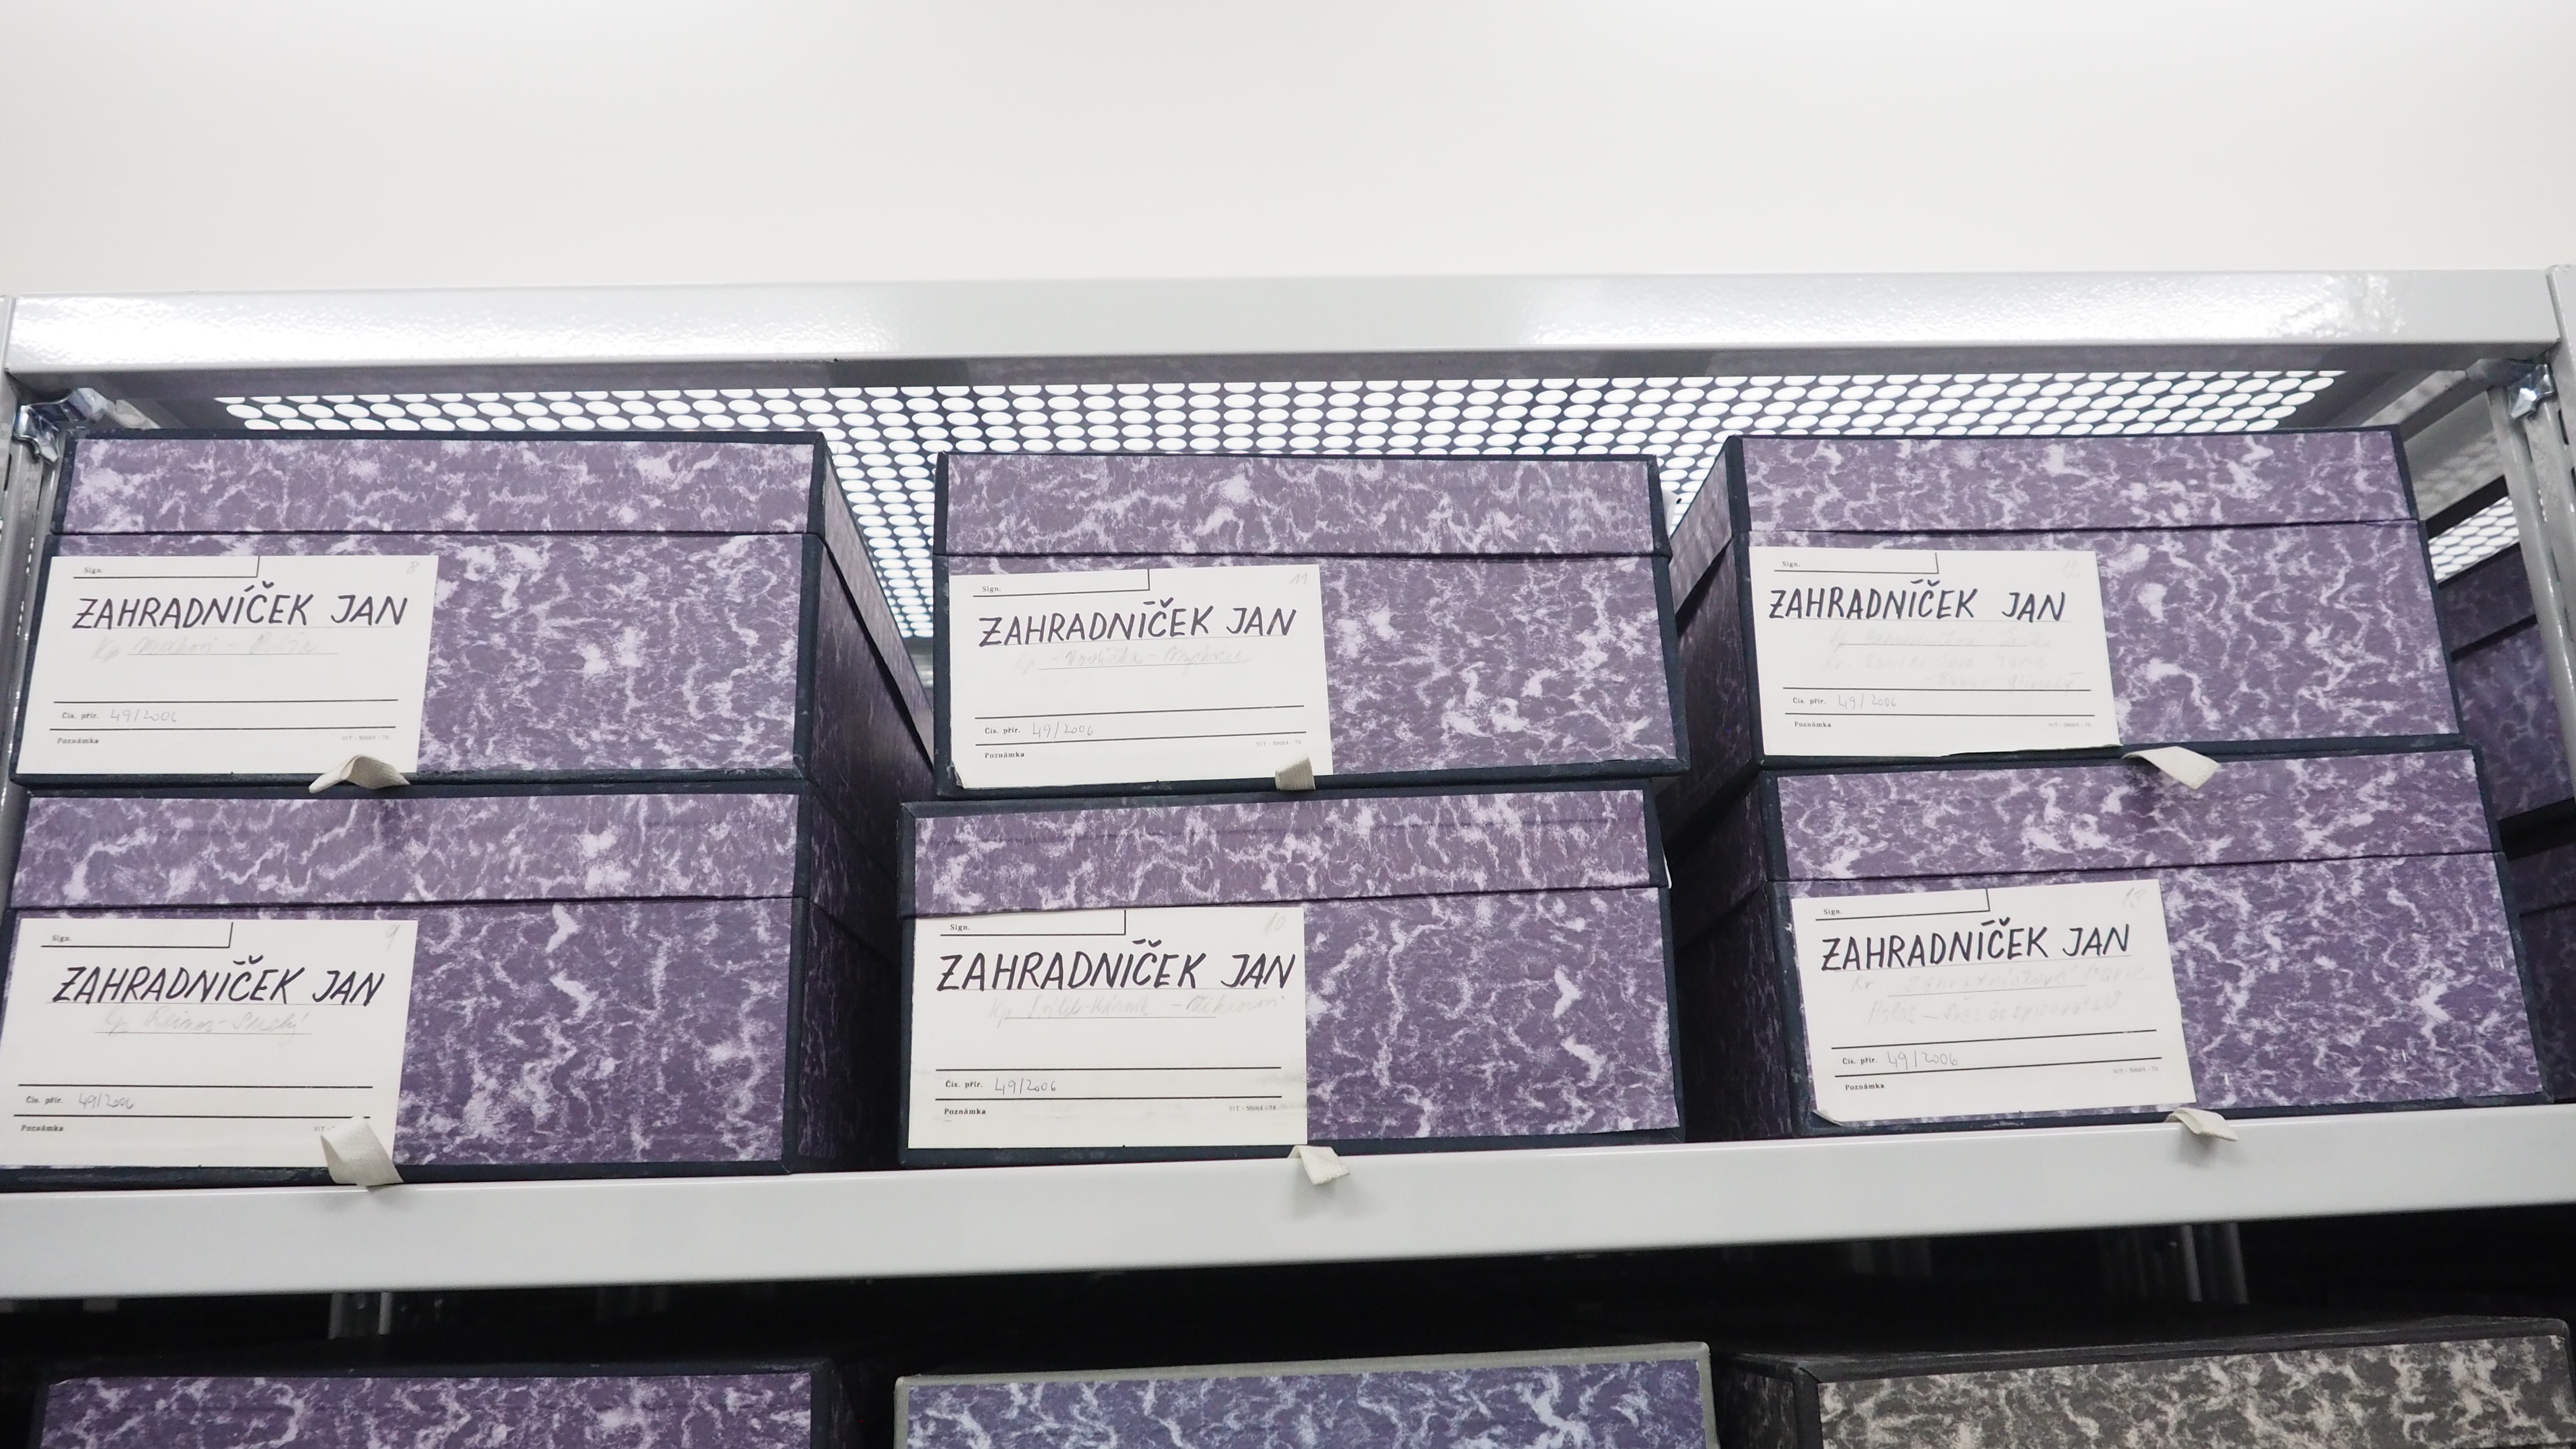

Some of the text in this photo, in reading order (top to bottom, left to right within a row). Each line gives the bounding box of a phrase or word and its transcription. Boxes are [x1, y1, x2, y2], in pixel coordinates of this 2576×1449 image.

[406, 561, 419, 574] 8
[1290, 572, 1308, 584] 11
[72, 580, 408, 630] ZAHRADNÍČEK JAN
[1769, 579, 2065, 623] ZAHRADNÍČEK JAN
[978, 596, 1297, 647] ZAHRADNÍČEK JAN
[110, 708, 177, 723] 49/2006
[1033, 721, 1094, 739] 49/2006
[2121, 887, 2146, 910] 13
[950, 924, 970, 932] Sign.
[1264, 912, 1285, 936] 10
[1821, 917, 2129, 971] ZAHRADNÍČEK JAN
[936, 938, 1296, 992] ZAHRADNÍČEK JAN
[52, 955, 385, 1007] ZAHRADNÍČEK JAN
[1887, 1050, 1958, 1068] 49/2006
[995, 1077, 1056, 1096] 49/2006
[1845, 1082, 1885, 1091] Poznámka
[78, 1092, 135, 1110] 49/2006
